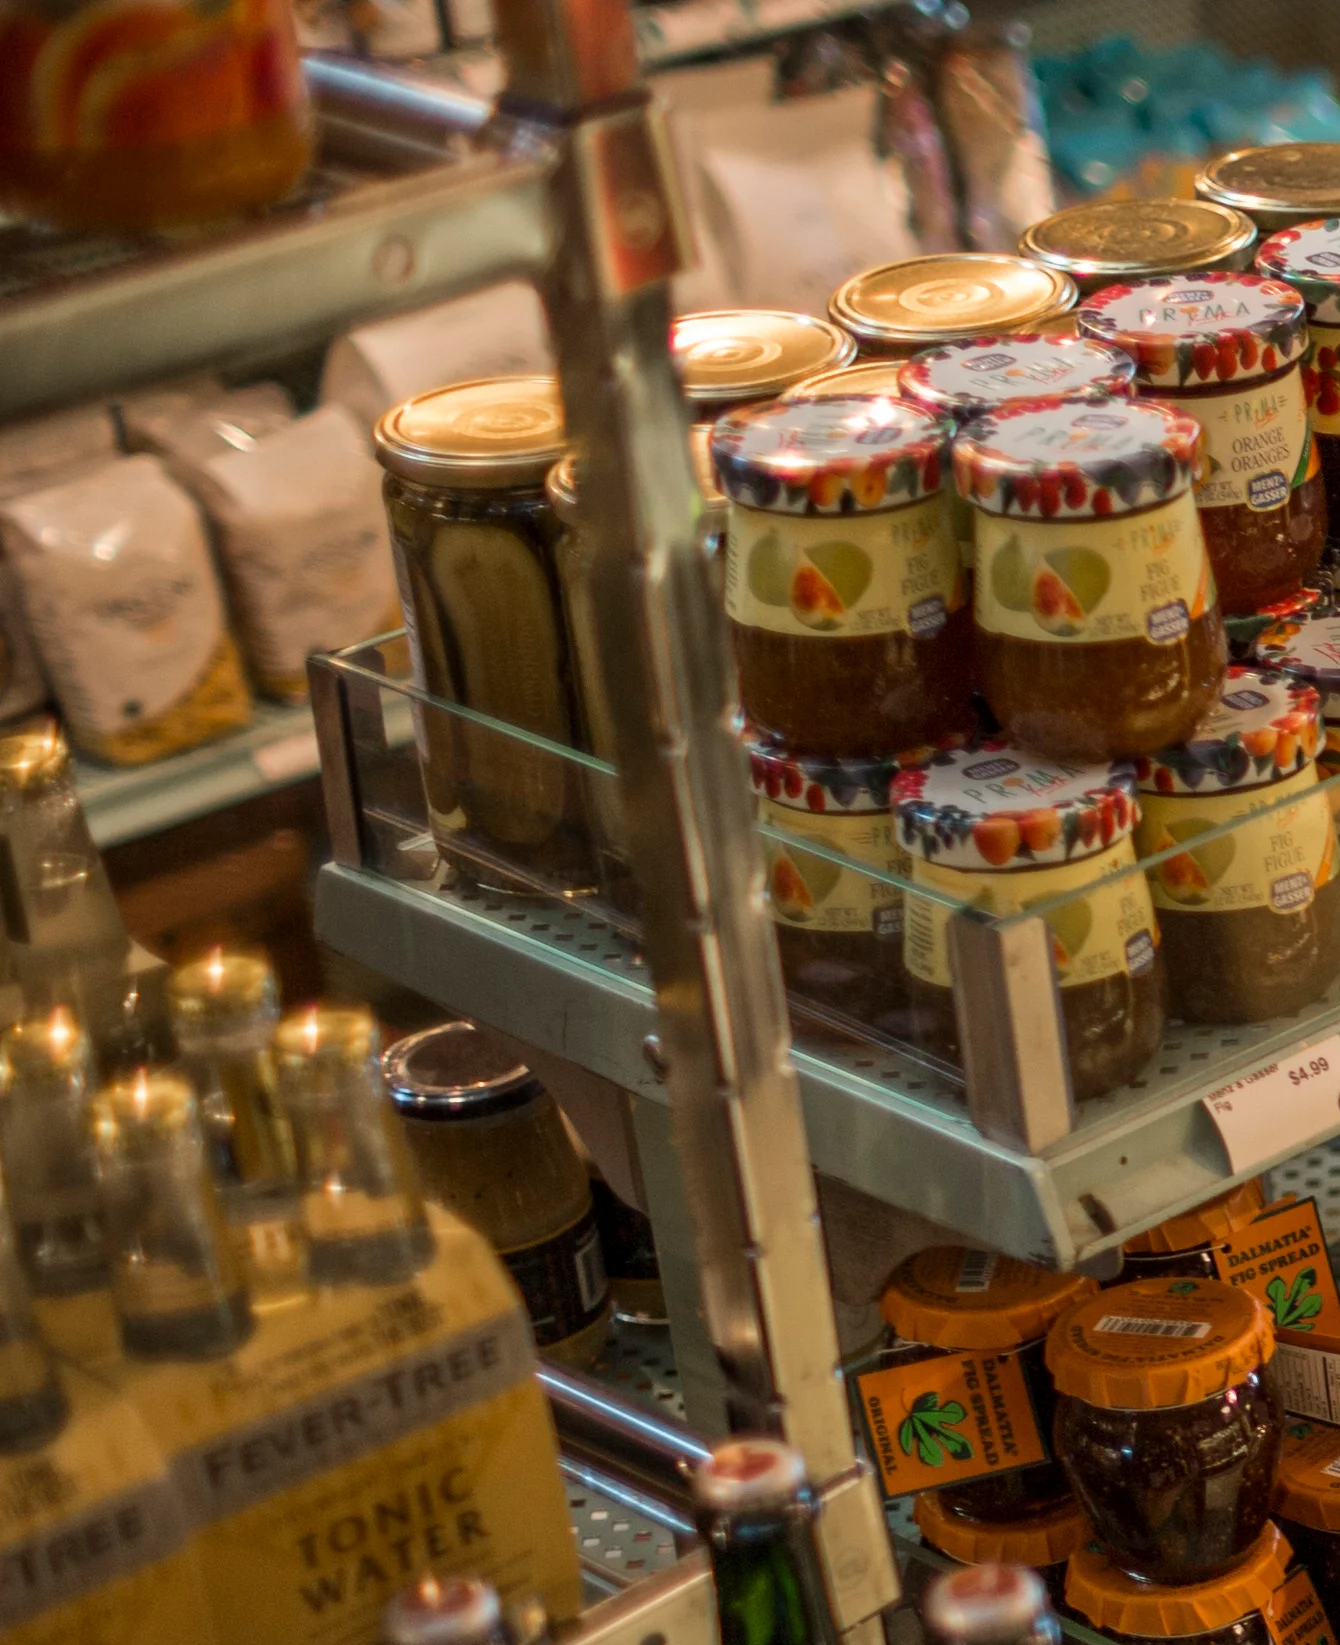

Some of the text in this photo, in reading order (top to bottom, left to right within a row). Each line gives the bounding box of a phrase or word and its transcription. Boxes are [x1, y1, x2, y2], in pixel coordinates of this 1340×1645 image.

[1231, 428, 1286, 454] ORANGE
[1230, 445, 1291, 473] ORANGES
[1250, 486, 1289, 508] GASSER
[1146, 560, 1169, 580] FIG
[1141, 576, 1181, 603] FIGUE
[1269, 831, 1294, 852] FIG
[1263, 846, 1306, 873] FIGUE
[1287, 1056, 1331, 1087] $4.99
[1212, 1100, 1234, 1115] Fig
[1227, 1229, 1308, 1269] DALMATIA
[1229, 1242, 1321, 1287] FIG SPREAD
[206, 1331, 502, 1491] FEVER-TREE
[961, 1359, 999, 1467] FIG SPREAD
[982, 1358, 1016, 1455] DALMATIA
[868, 1395, 899, 1477] ORIGINAL
[300, 1465, 475, 1567] TONIC
[299, 1509, 490, 1615] WATER
